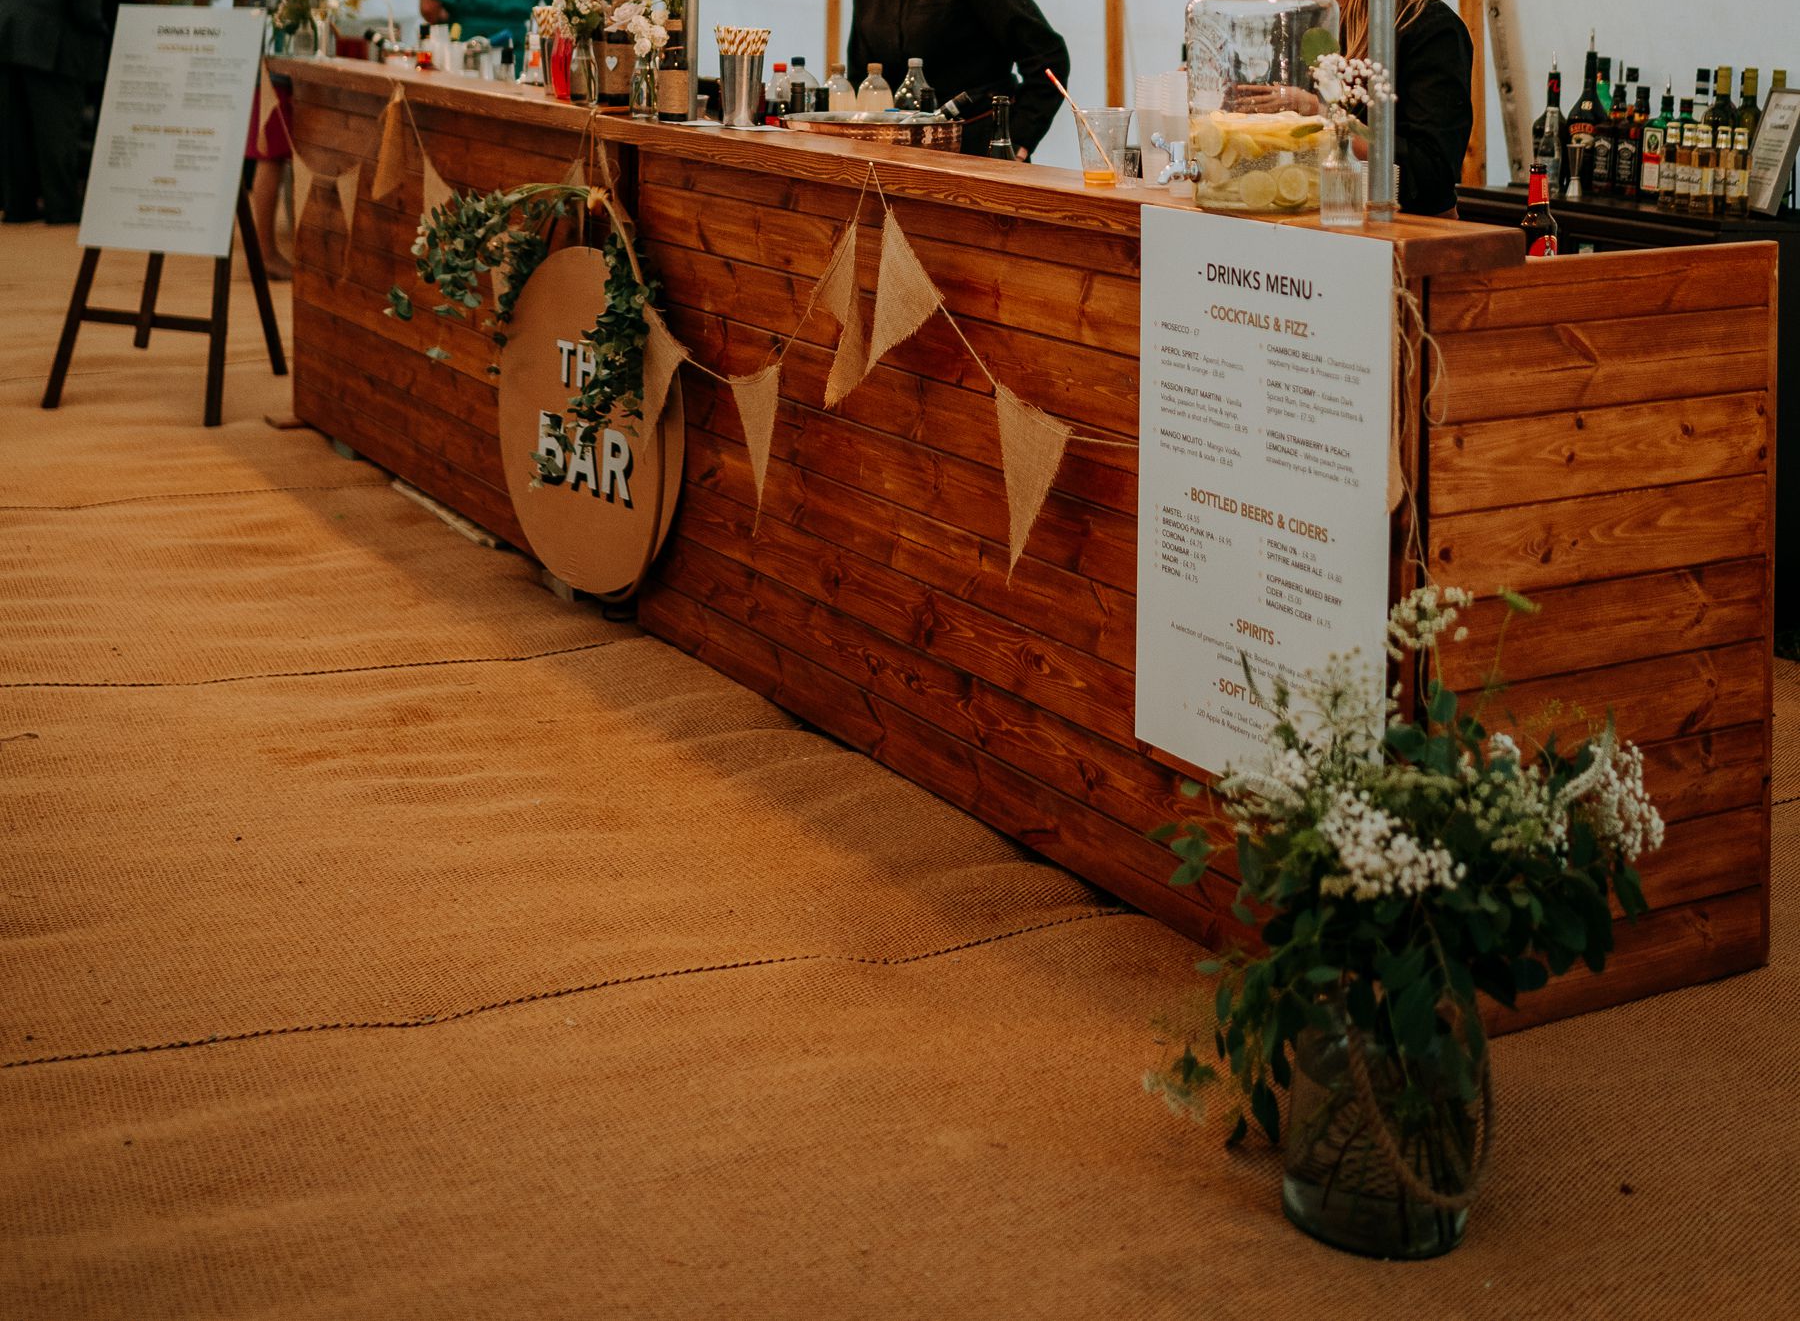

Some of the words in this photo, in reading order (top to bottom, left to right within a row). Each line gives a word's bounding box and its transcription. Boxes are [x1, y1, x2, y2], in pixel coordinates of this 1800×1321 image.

[1207, 263, 1261, 291] DRINKS
[1266, 273, 1312, 301] MENU
[1162, 321, 1190, 335] PROSECCO
[1211, 304, 1270, 330] COCKTAILS
[1274, 317, 1282, 333] &
[1285, 319, 1308, 338] FIZZ
[1161, 345, 1181, 357] APEROL
[1183, 350, 1199, 361] SPRITZ
[1302, 351, 1323, 363] BELLINI
[1161, 380, 1183, 393] PASSION
[1185, 386, 1199, 396] FRUIT
[1200, 390, 1222, 402] MARTINI
[1267, 379, 1282, 390] DARK
[1292, 384, 1316, 397] STORMY
[1161, 428, 1181, 440] MANGO
[1182, 434, 1203, 446] MOJITO
[1266, 429, 1285, 441] VIRGIN
[1287, 434, 1323, 451] STRAWBERRY
[1331, 446, 1350, 458] PEACH
[1266, 442, 1298, 457] LEMONADE
[1163, 505, 1183, 518] AMSTEL
[1191, 487, 1238, 515] BOTTLED
[1241, 502, 1274, 526] BEERS
[1277, 513, 1285, 530] &
[1289, 517, 1328, 544] CIDERS
[1162, 528, 1186, 543] CORONA
[1163, 517, 1189, 533] BREWDOG
[1190, 526, 1205, 537] PUNK
[1206, 530, 1214, 540] IPA
[1162, 540, 1189, 556] DOOMBAR
[1267, 539, 1288, 553] PERONI
[1162, 564, 1181, 578] PERONI
[1267, 552, 1290, 566] SPITFIRE
[1291, 559, 1311, 573] AMBER
[1312, 566, 1323, 577] ALE
[1266, 586, 1283, 599] CIDER
[1267, 574, 1304, 593] KOPPARBERG
[1305, 586, 1323, 600] MIXED
[1324, 593, 1342, 607] BERRY
[1266, 598, 1294, 615] MAGNERS
[1295, 609, 1312, 622] CIDER
[1171, 621, 1175, 629] A
[1237, 618, 1274, 646] SPIRITS
[1219, 677, 1247, 702] SOFT
